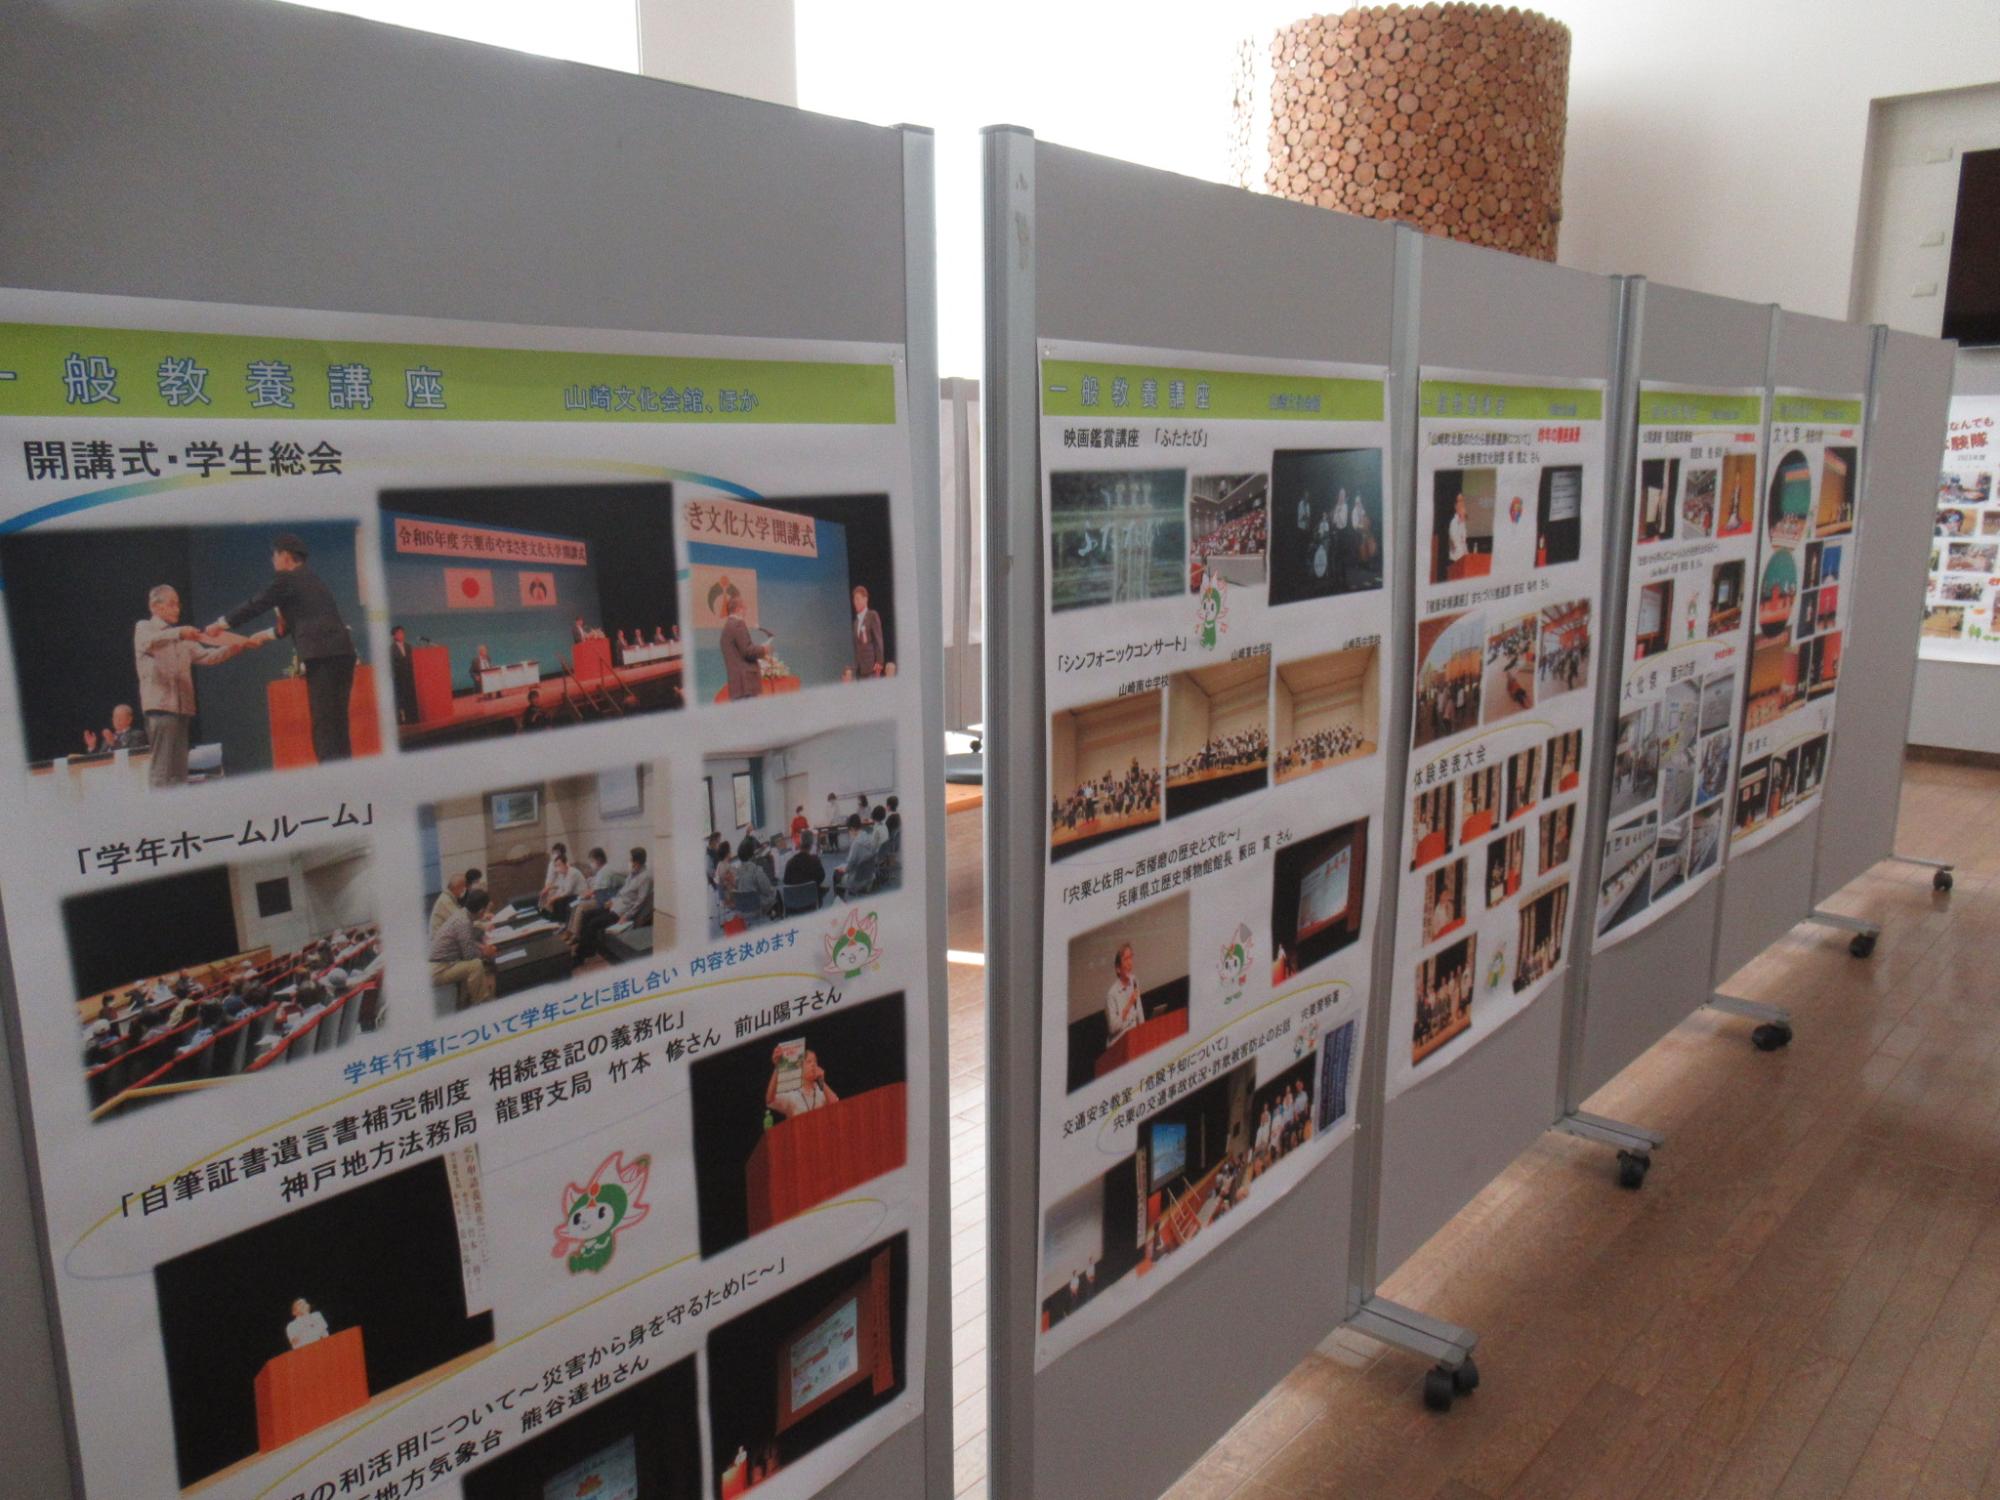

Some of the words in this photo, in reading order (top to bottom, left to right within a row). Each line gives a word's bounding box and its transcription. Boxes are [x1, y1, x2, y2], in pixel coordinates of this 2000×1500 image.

[1050, 376, 1212, 409] 一般教養講座
[23, 440, 343, 480] 開講式・学生総会
[1063, 428, 1140, 449] 映画鑑賞講座
[1153, 428, 1208, 449] 「ふたたび」
[685, 501, 816, 549] き文化大学開講式
[1057, 636, 1188, 674] 「シンフォニックコンサート」
[77, 802, 373, 876] 「学年ホームルーム」
[689, 928, 800, 976] 内容を決めます
[488, 1009, 686, 1092] 相続登記の義務化」
[281, 1110, 478, 1203] 神戸地方法務局
[494, 1071, 593, 1125] 龍野支局
[608, 1051, 652, 1085] 竹本
[666, 1028, 721, 1064] 修さん
[734, 987, 842, 1039] 前山陽子さん
[520, 1354, 650, 1434] 熊谷達也さん
